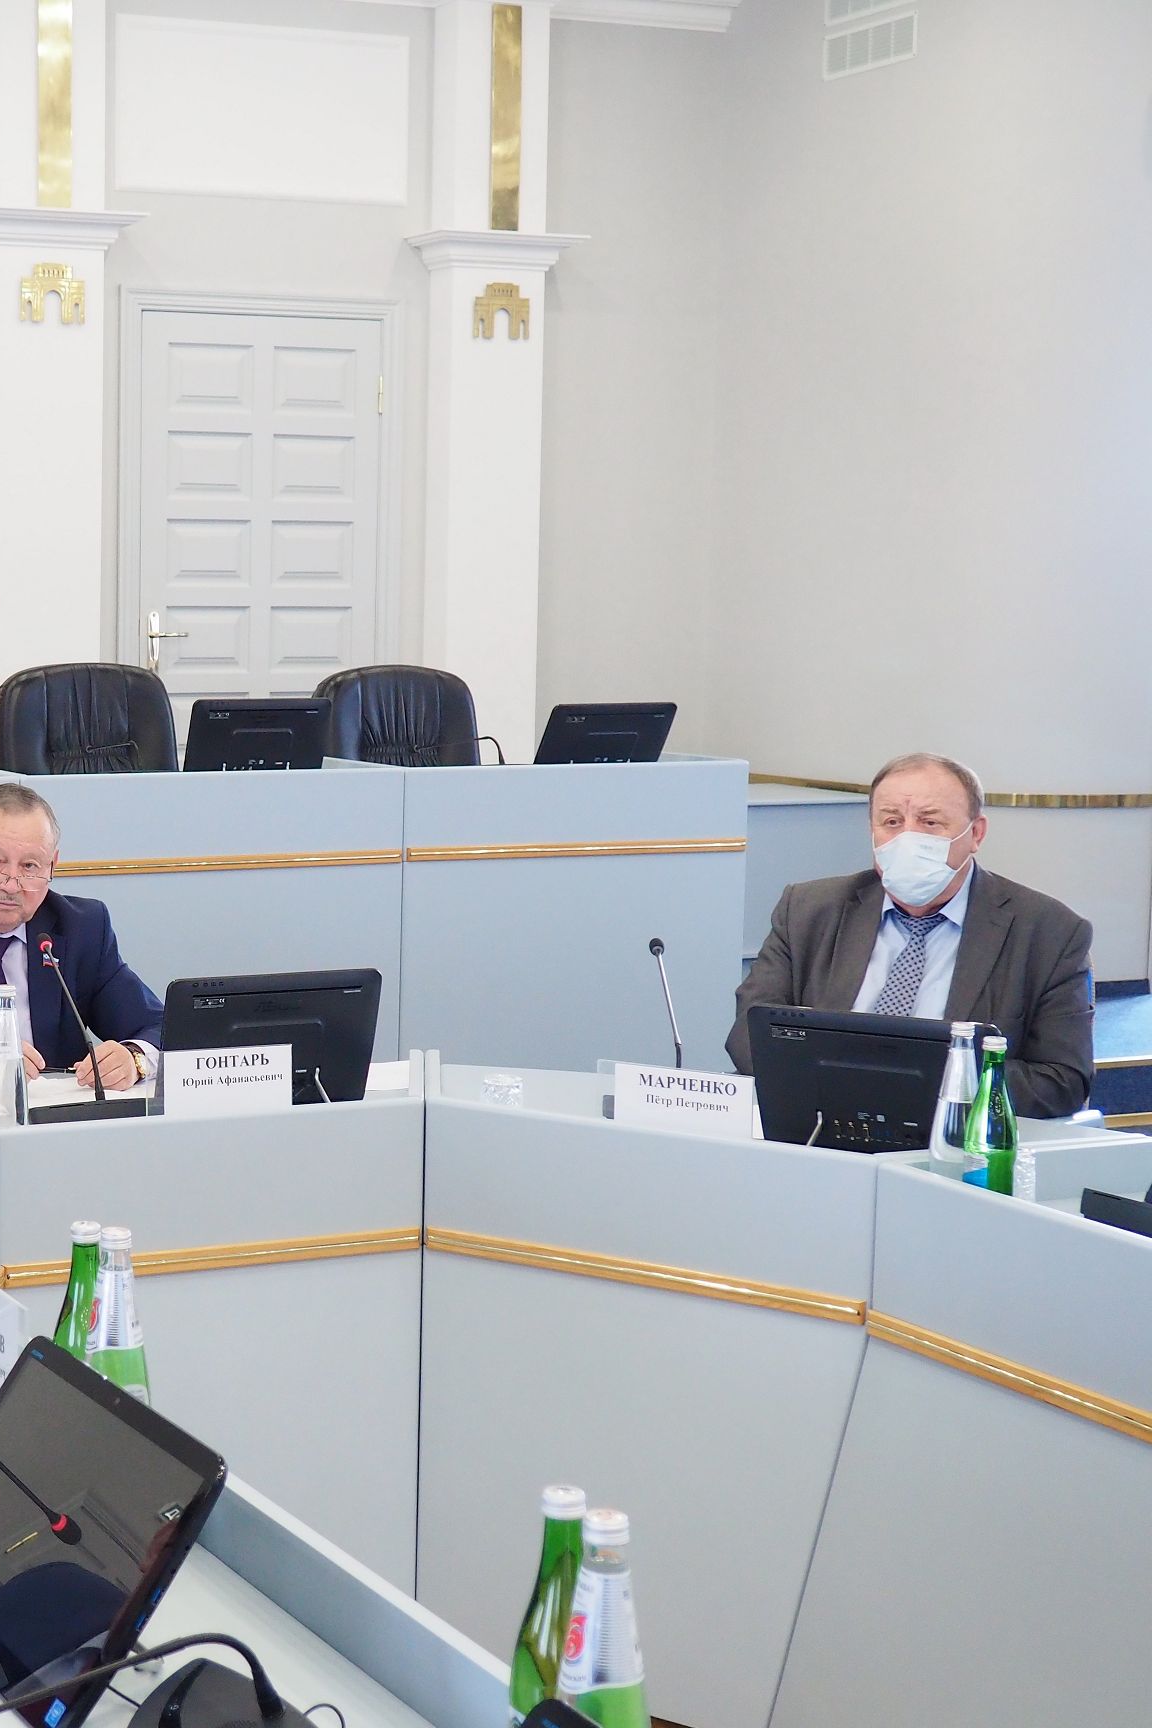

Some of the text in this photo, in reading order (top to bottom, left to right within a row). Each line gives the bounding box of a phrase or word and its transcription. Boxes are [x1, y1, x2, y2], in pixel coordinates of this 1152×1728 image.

[196, 1053, 269, 1069] ГОНТАРЬ
[182, 1073, 283, 1088] Юрий Афанасьевич
[639, 1073, 737, 1096] МАРЧЕНКО
[646, 1094, 729, 1112] Пётр Петрович
